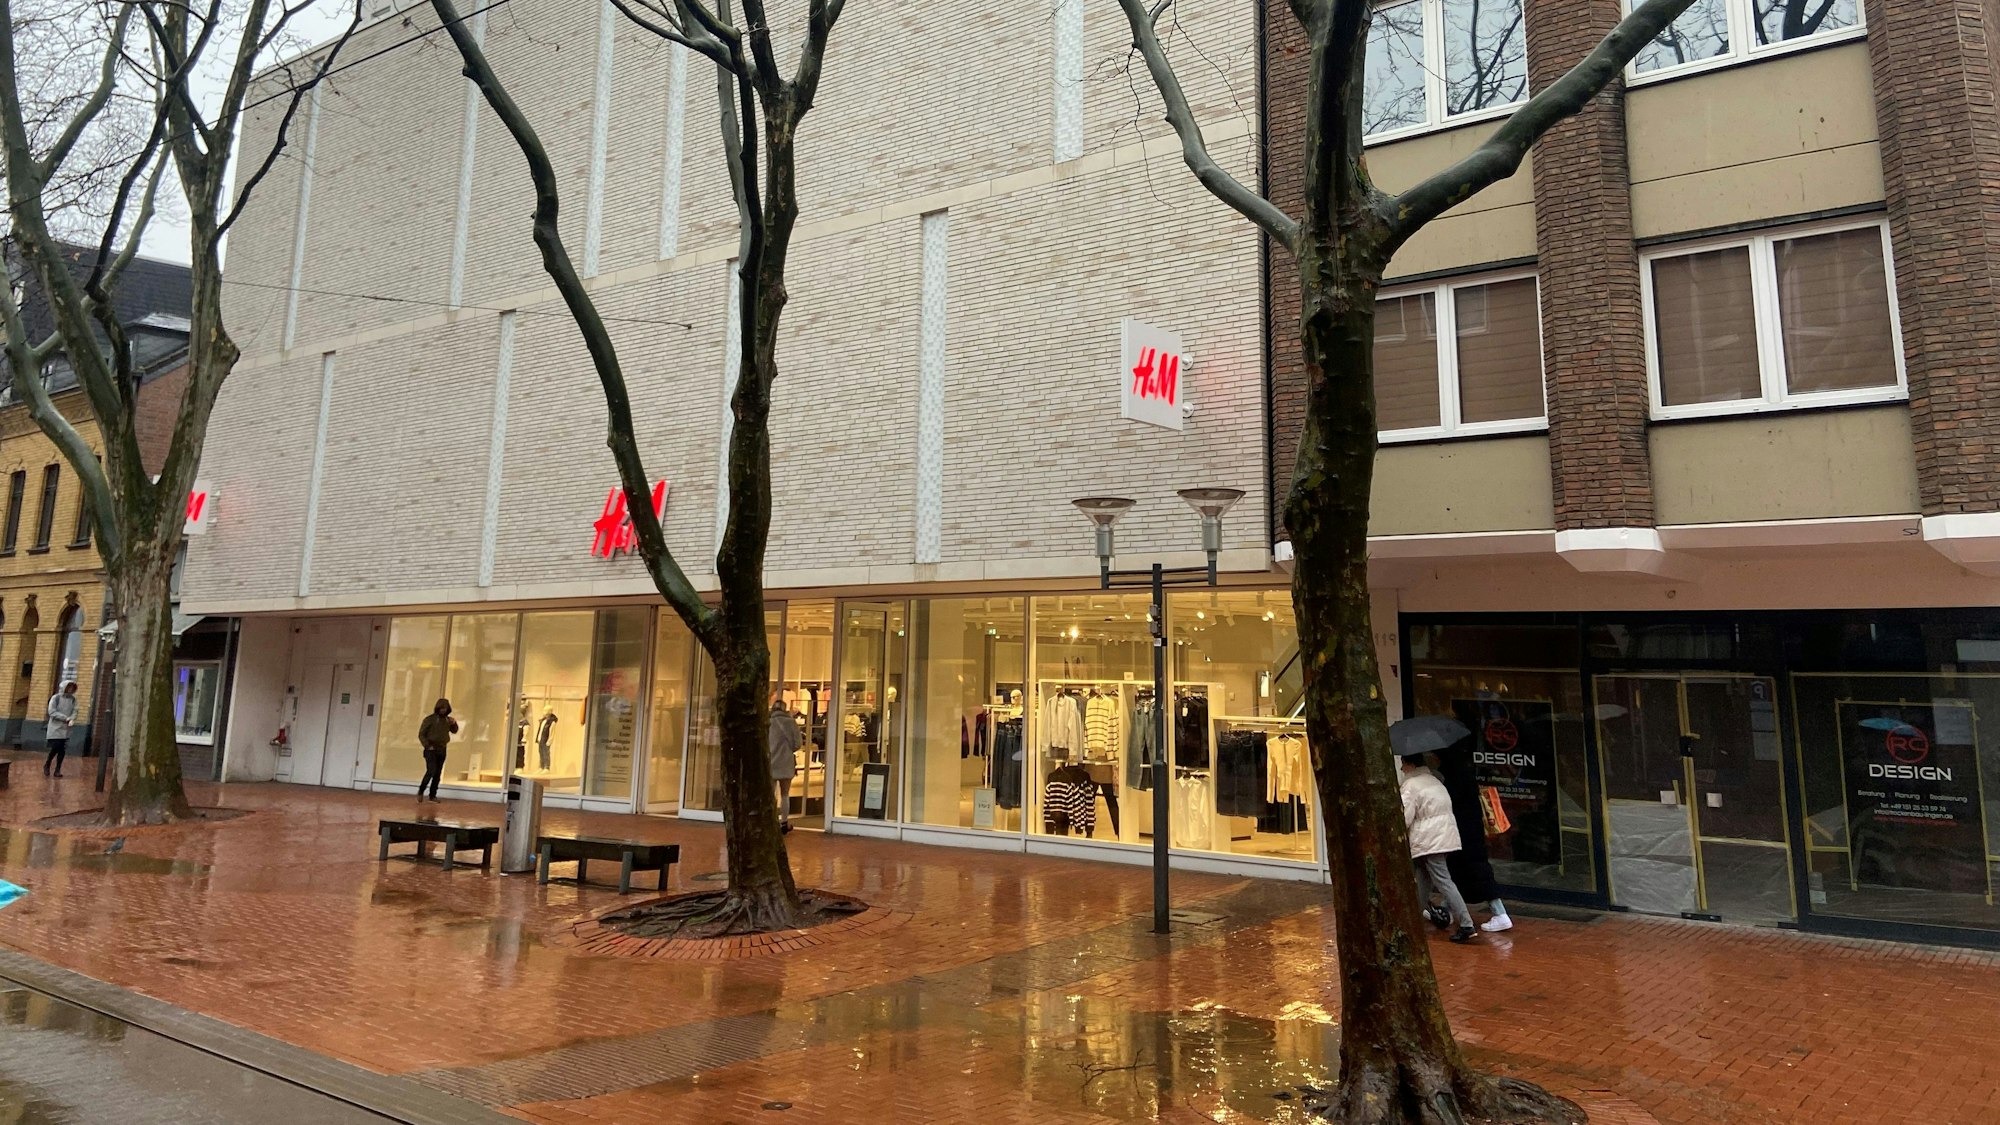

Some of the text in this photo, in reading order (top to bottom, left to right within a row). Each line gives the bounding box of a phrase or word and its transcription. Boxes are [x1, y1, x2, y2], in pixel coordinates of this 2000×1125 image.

[1132, 346, 1178, 406] H&M
[1473, 752, 1535, 766] DESIGN
[1869, 764, 1952, 781] DESIGN
